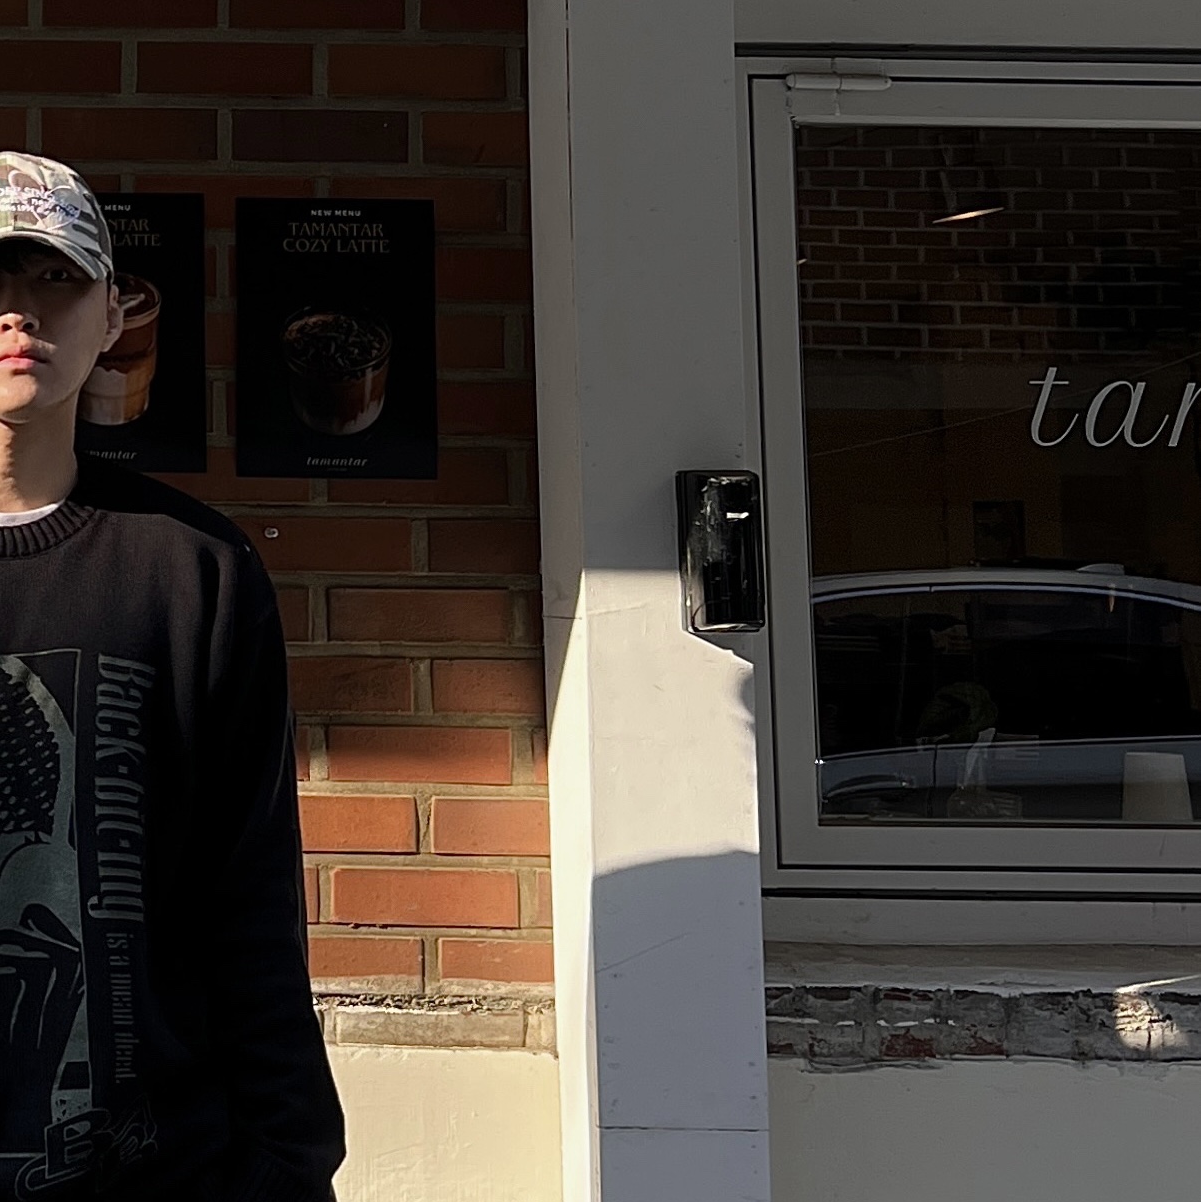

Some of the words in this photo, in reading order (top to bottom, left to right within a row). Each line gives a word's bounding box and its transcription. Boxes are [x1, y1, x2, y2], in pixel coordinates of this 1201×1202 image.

[311, 209, 332, 217] NEW
[334, 209, 362, 217] MENU
[108, 218, 150, 232] NTAR
[287, 222, 384, 237] TAMANTAR
[112, 233, 162, 247] LATTE
[282, 239, 331, 253] COZY
[336, 239, 391, 254] LATTE
[306, 456, 368, 467] tamantar
[105, 931, 135, 950] is
[108, 956, 132, 968] a
[109, 973, 136, 1026] mean
